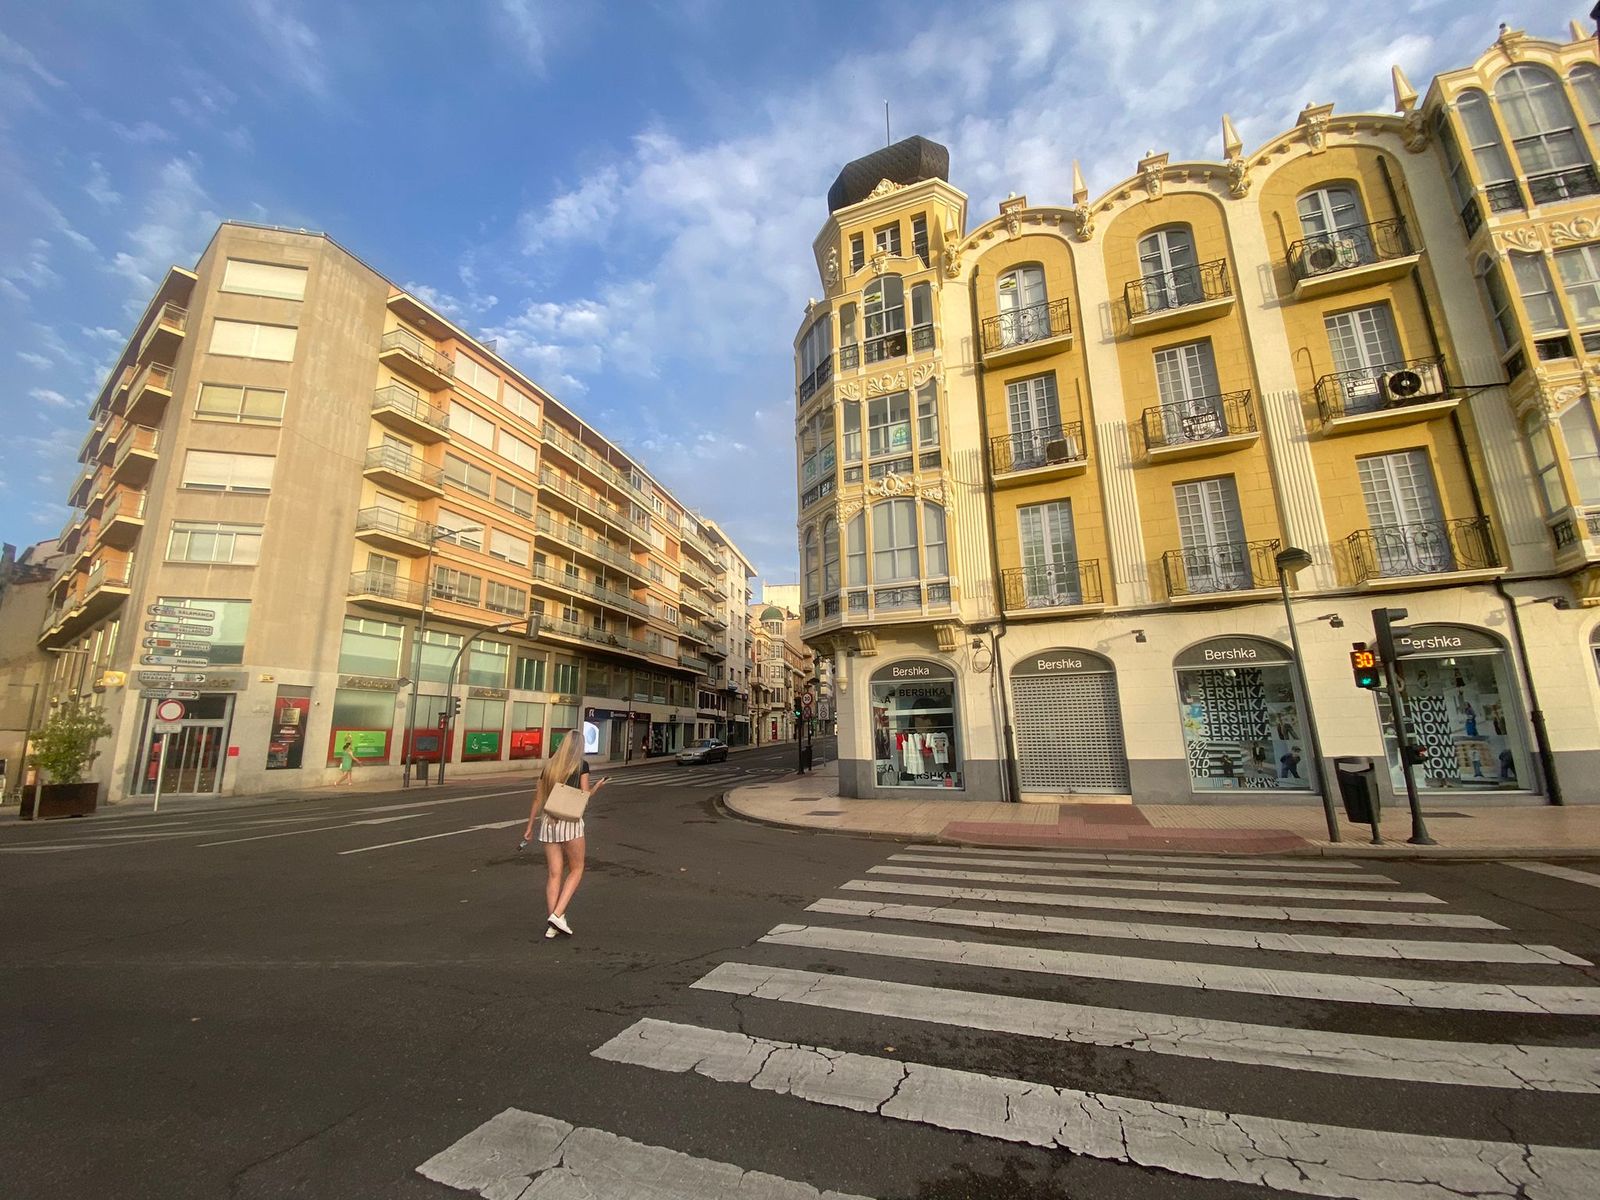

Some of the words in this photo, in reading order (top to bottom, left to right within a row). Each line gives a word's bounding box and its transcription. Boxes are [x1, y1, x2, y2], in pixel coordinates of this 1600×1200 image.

[1204, 648, 1257, 660] Bershka
[1037, 659, 1082, 670] Bershka
[1355, 652, 1374, 668] 30
[892, 667, 930, 677] Bershka
[899, 688, 947, 697] BERSHKA
[1409, 700, 1447, 711] NOW
[1411, 711, 1449, 722] NOW
[1202, 724, 1272, 736] BERSHKA
[1413, 723, 1451, 734] NOW
[1416, 734, 1453, 746] NOW
